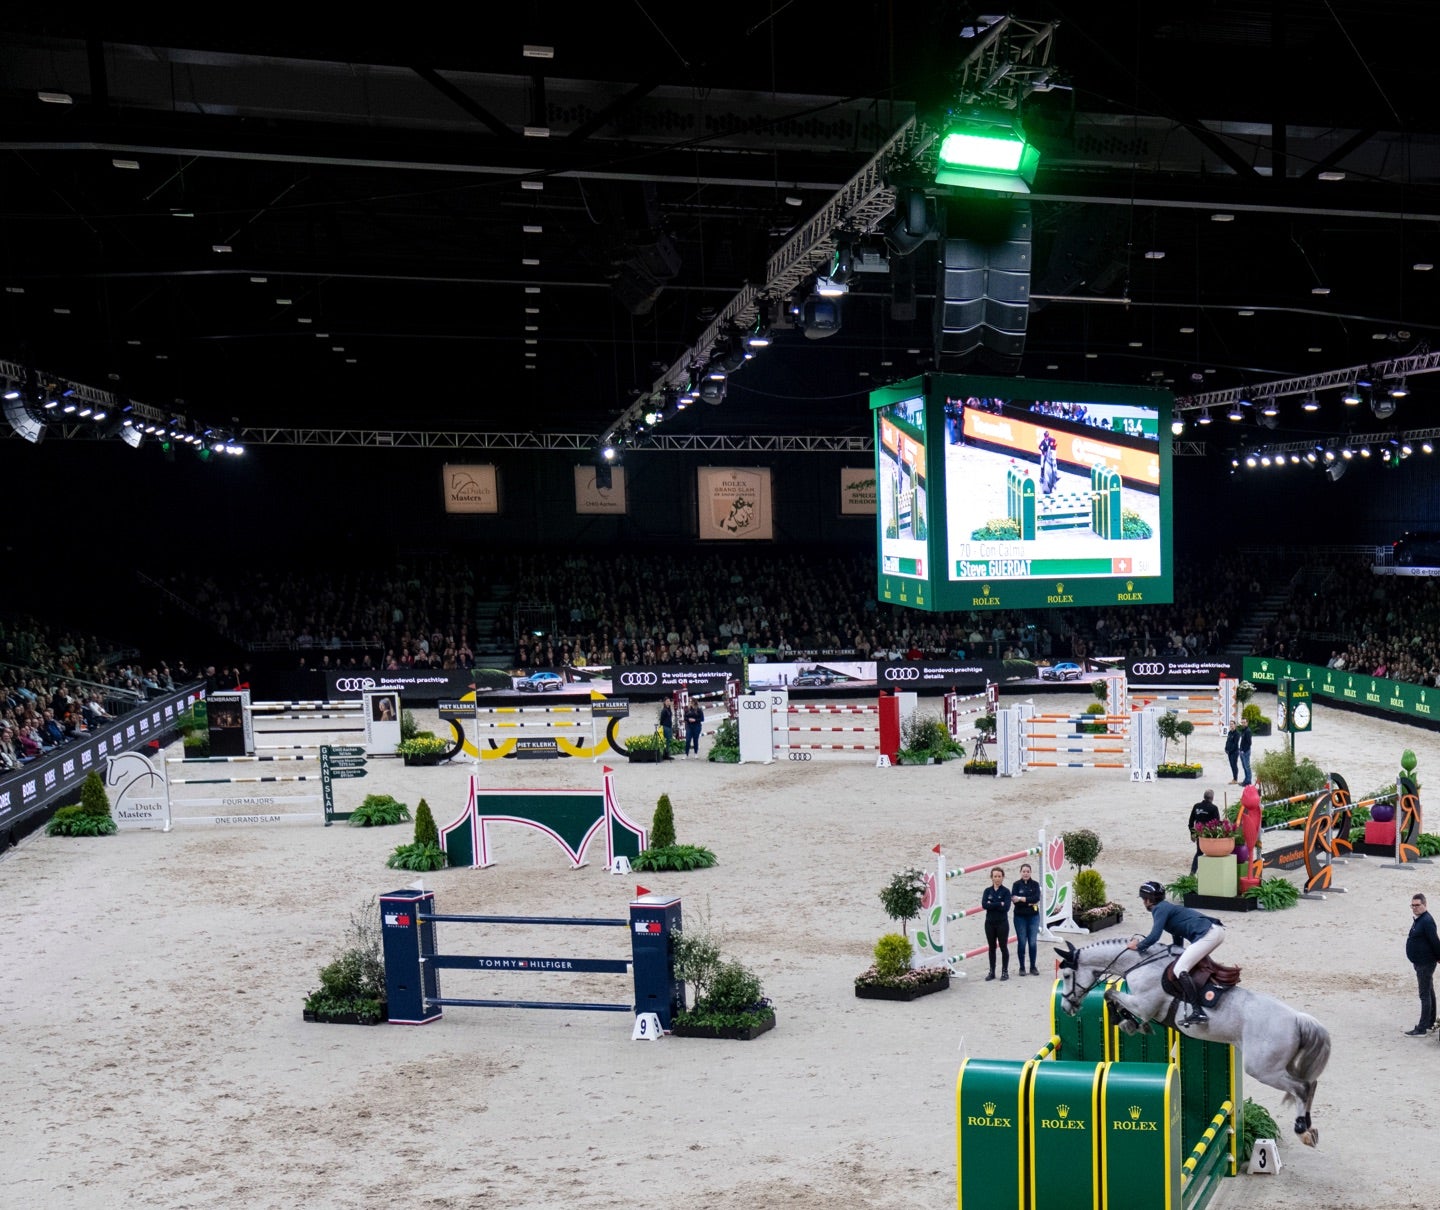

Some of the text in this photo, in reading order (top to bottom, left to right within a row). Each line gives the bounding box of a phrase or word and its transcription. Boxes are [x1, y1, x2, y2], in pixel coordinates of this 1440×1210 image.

[960, 560, 1032, 576] Steve GUERDAT
[972, 597, 1000, 606] ROLEX
[1047, 595, 1074, 603] ROLEX
[1118, 592, 1142, 600] ROLEX
[416, 677, 449, 686] prachtige
[1416, 702, 1430, 714] ROLEX
[321, 747, 333, 814] GRAND SLAM
[1133, 772, 1140, 780] 10
[1146, 772, 1151, 780] A
[616, 860, 620, 871] 4
[641, 1019, 646, 1035] 9
[968, 1116, 1012, 1128] ROLEX
[1041, 1119, 1086, 1130] ROLEX
[1113, 1120, 1158, 1131] ROLEX
[1259, 1148, 1267, 1168] 3
